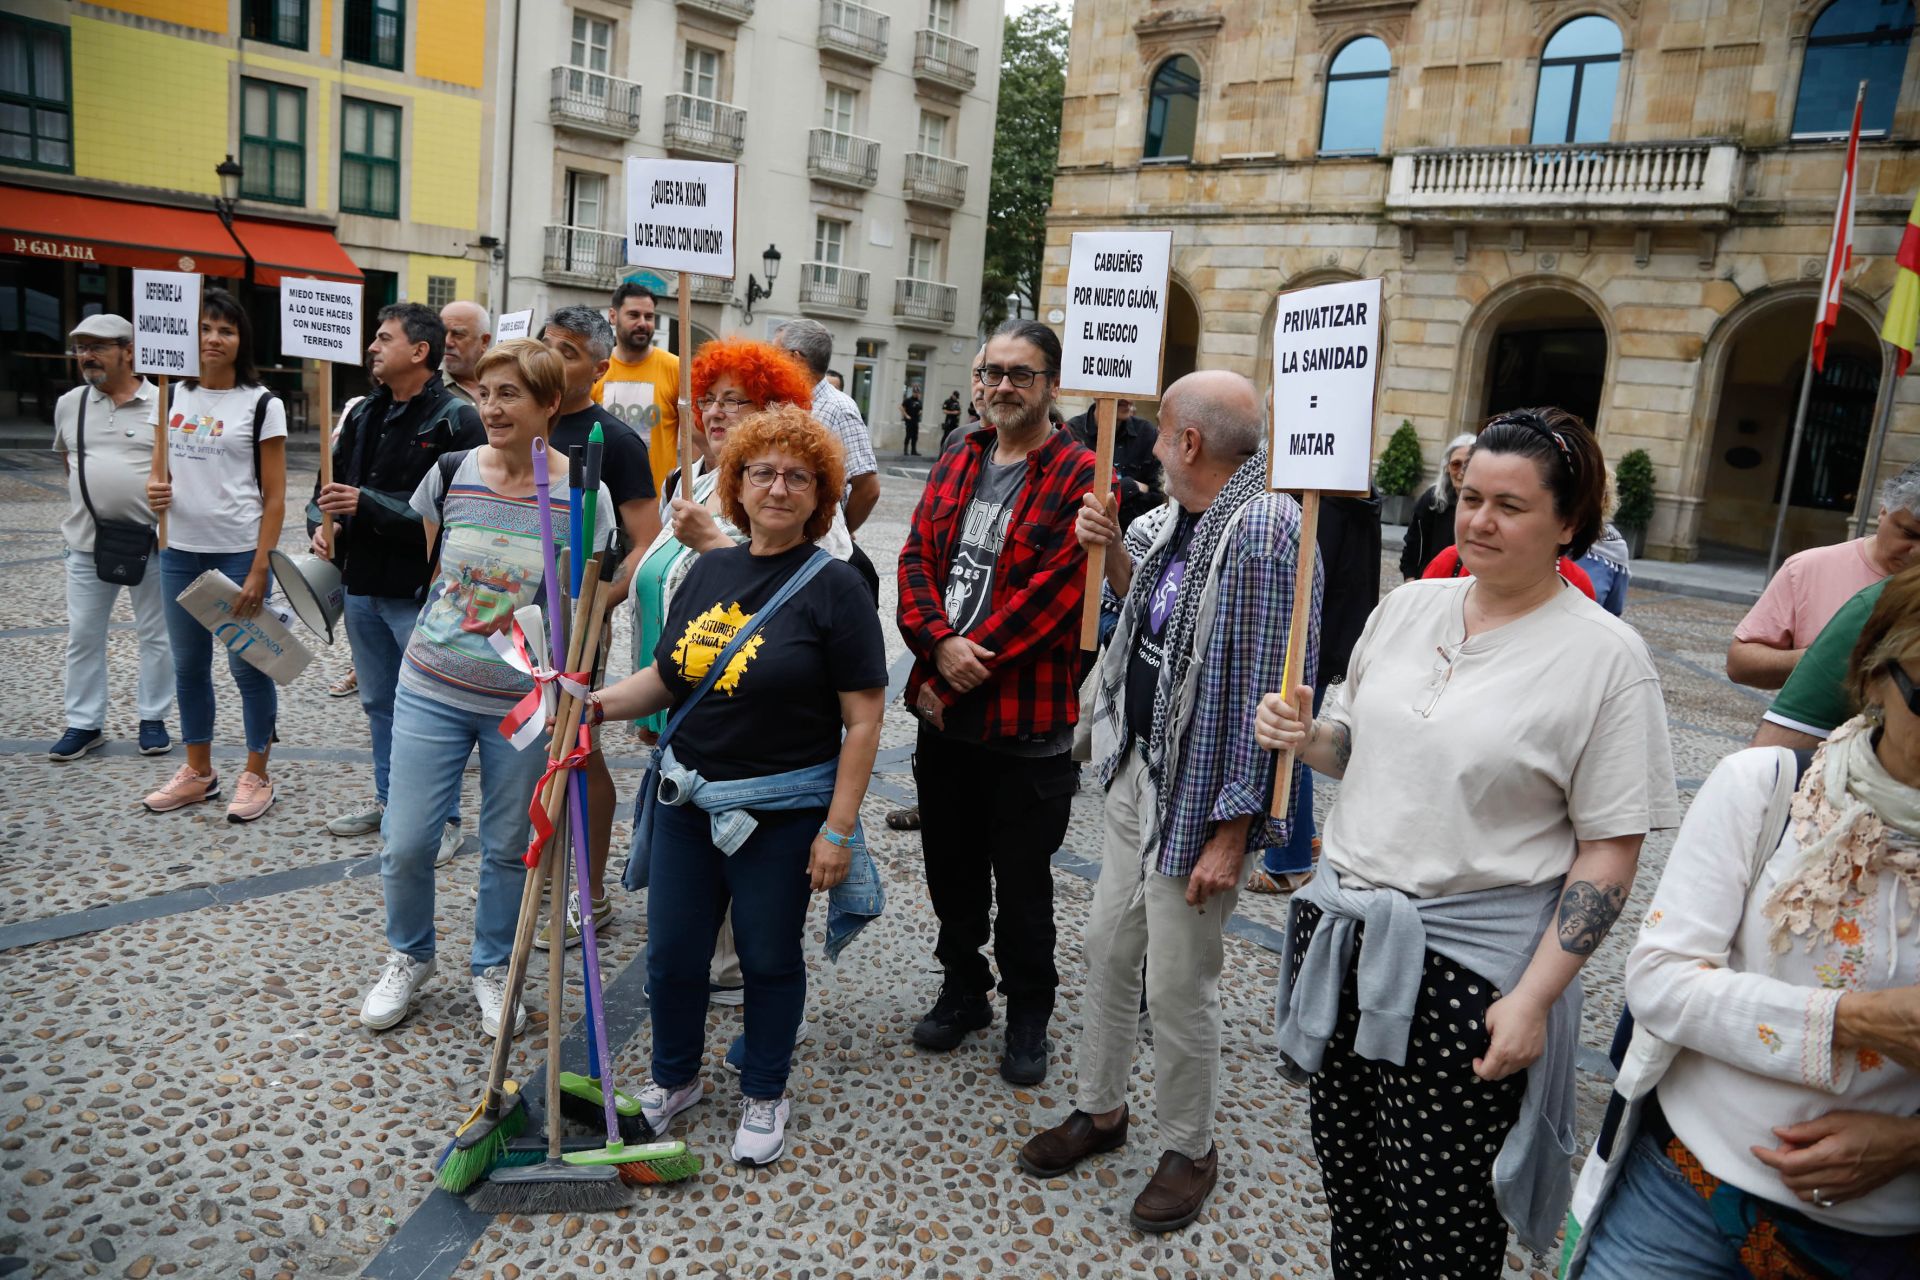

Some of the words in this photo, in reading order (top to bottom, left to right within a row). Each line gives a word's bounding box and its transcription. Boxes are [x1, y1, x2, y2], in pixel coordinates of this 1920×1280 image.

[651, 179, 673, 209] ¿QUIES
[675, 181, 684, 206] PA
[685, 177, 707, 207] XIXÓN
[635, 222, 644, 246] LO
[645, 223, 653, 247] DE
[655, 225, 676, 250] AYUSO
[678, 226, 691, 251] CON
[693, 224, 723, 255] QUIRÓN?
[30, 241, 96, 260] GALANA
[1094, 250, 1143, 273] CABUEÑES
[146, 282, 173, 301] DEFIENDE
[174, 284, 182, 302] LA
[289, 288, 313, 300] MIEDO
[315, 292, 353, 307] TENEMOS,
[1074, 286, 1092, 305] POR
[1094, 288, 1125, 308] NUEVO
[1127, 286, 1159, 313] GIJÓN,
[289, 304, 294, 312] A
[296, 304, 306, 314] LO
[308, 306, 324, 317] QUE
[326, 309, 353, 321] HACEIS
[1283, 302, 1367, 333] PRIVATIZAR
[139, 314, 161, 333] SANIDAD
[293, 319, 309, 329] CON
[311, 321, 351, 335] NUESTROS
[1083, 321, 1094, 340] EL
[1096, 323, 1138, 344] NEGOCIO
[303, 335, 343, 349] TERRENOS
[142, 347, 148, 365] ES
[149, 348, 156, 366] LA
[157, 349, 165, 367] DE
[1082, 356, 1095, 375] DE
[1096, 355, 1132, 378] QUIRÓN
[1282, 351, 1298, 373] LA
[1302, 345, 1368, 372] SANIDAD
[1289, 433, 1335, 455] MATAR
[699, 619, 736, 638] ASTURIES
